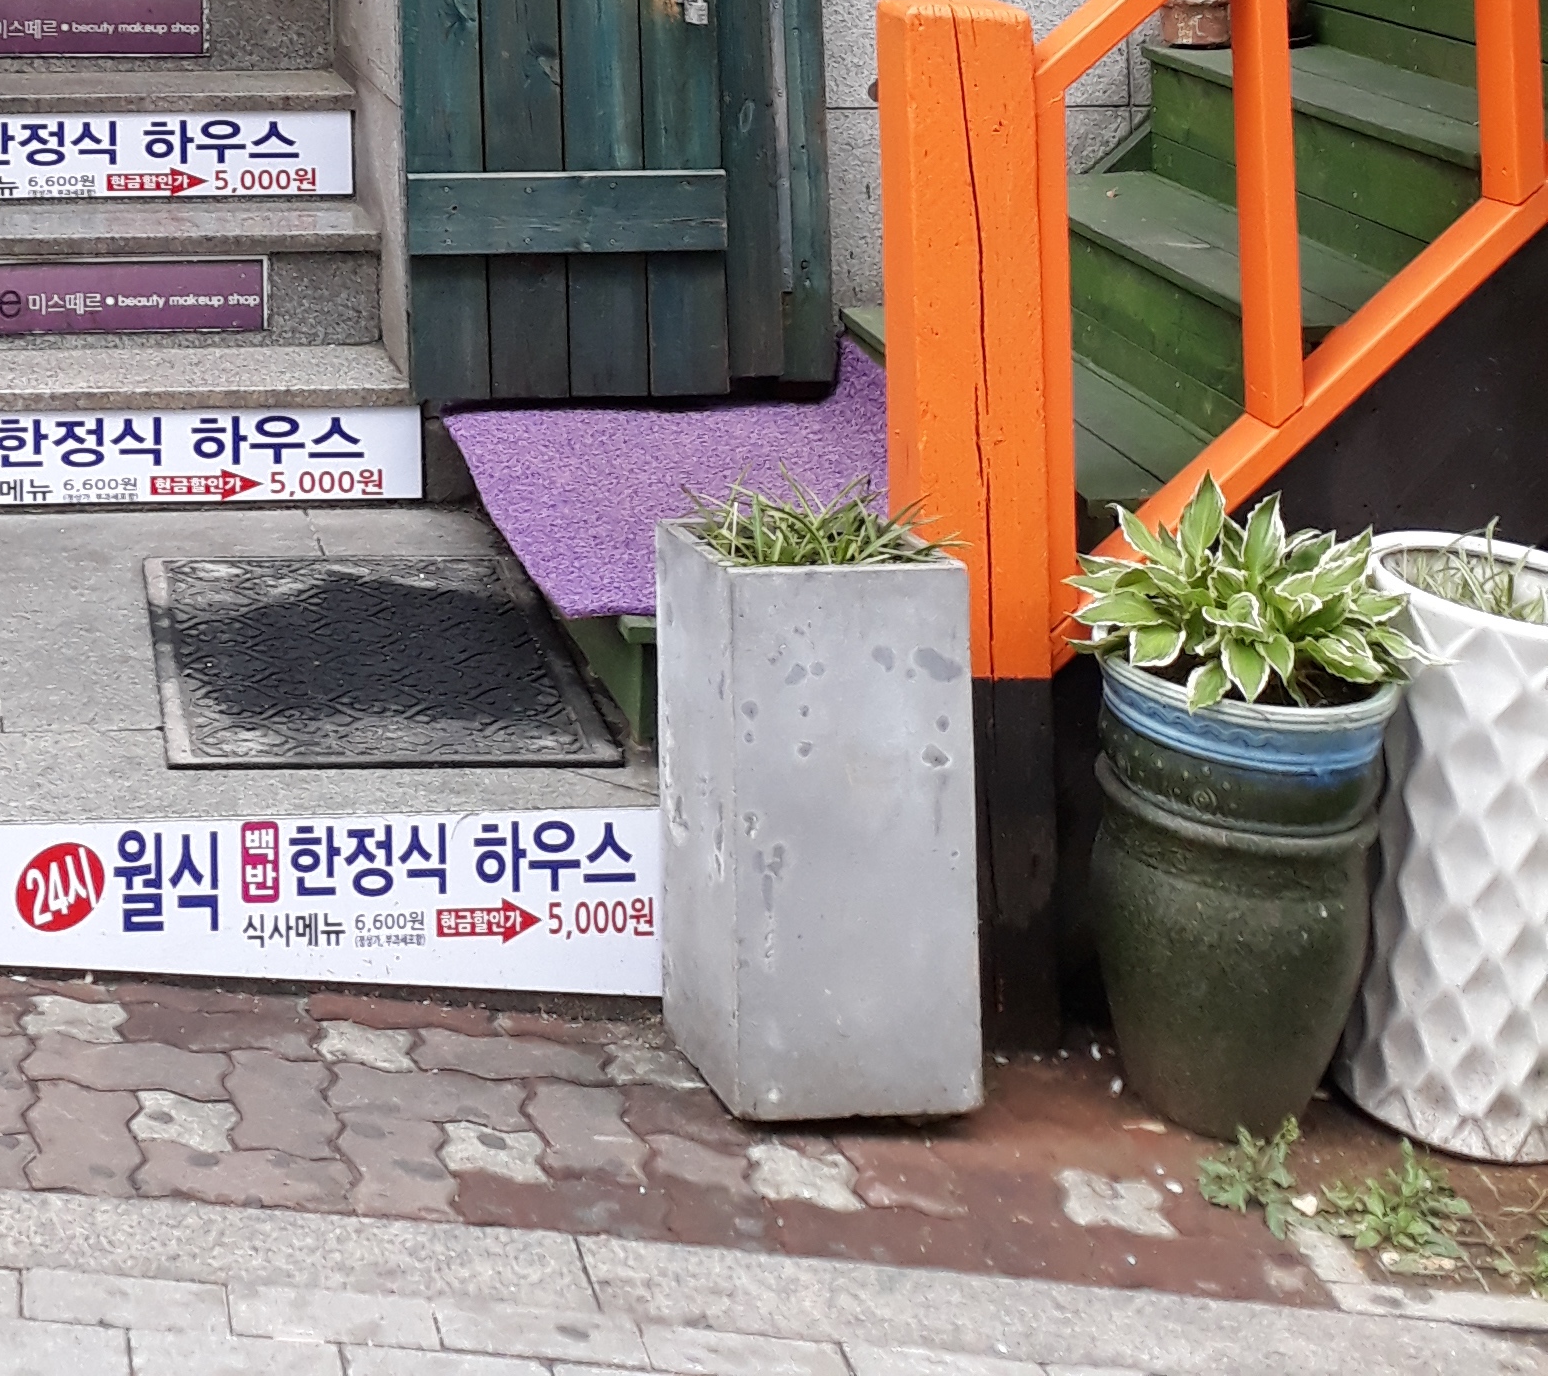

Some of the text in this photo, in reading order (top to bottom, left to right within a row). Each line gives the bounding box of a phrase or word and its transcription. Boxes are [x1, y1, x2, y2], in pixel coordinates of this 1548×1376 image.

[118, 22, 167, 35] makeup
[170, 21, 200, 35] shop
[142, 120, 299, 165] 하우스
[110, 174, 189, 189] 현금할인가
[213, 168, 318, 195] 5,000원
[169, 294, 224, 309] makeup
[228, 291, 260, 308] shop
[192, 414, 366, 462] 하우스
[155, 477, 242, 493] 현금할인가
[269, 469, 385, 497] 5,000원
[26, 829, 218, 932] 24시 월식
[245, 830, 276, 895] 백반
[289, 819, 638, 897] 한정식 하우스
[242, 897, 654, 948] 식사메뉴 6,600원 현금할인가 5,000원
